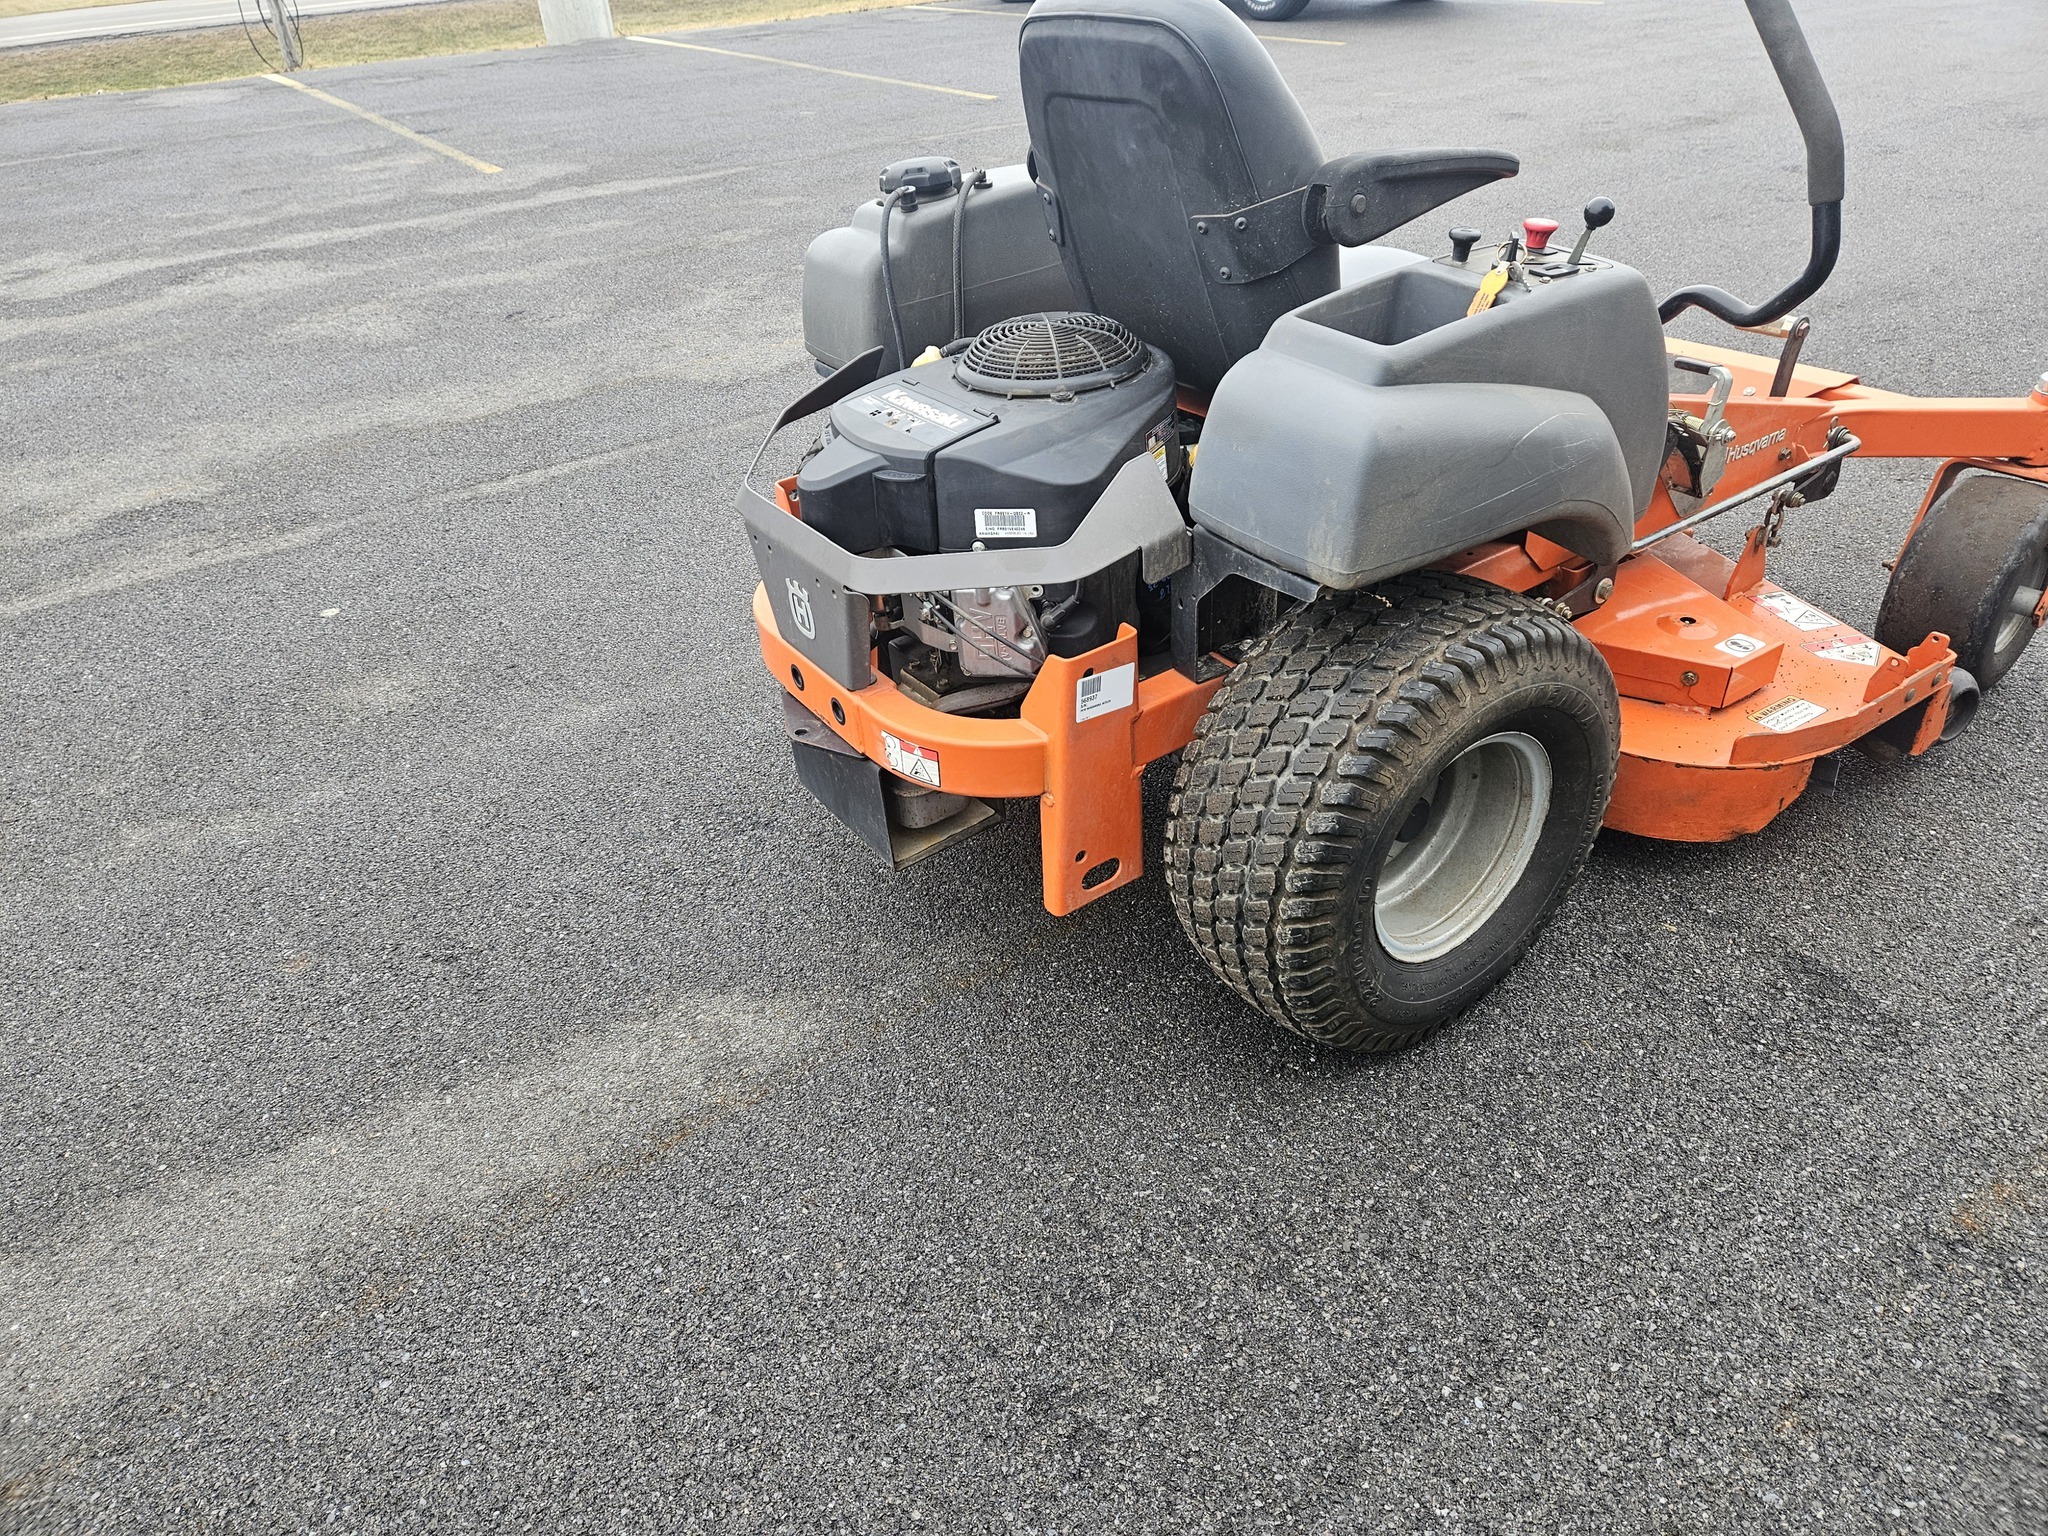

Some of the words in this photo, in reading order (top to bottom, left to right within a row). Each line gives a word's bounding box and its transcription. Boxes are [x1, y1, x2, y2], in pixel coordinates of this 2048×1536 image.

[881, 388, 969, 429] Kawasaki
[1726, 427, 1787, 464] Husqvarna
[1759, 698, 1796, 717] WARNING
